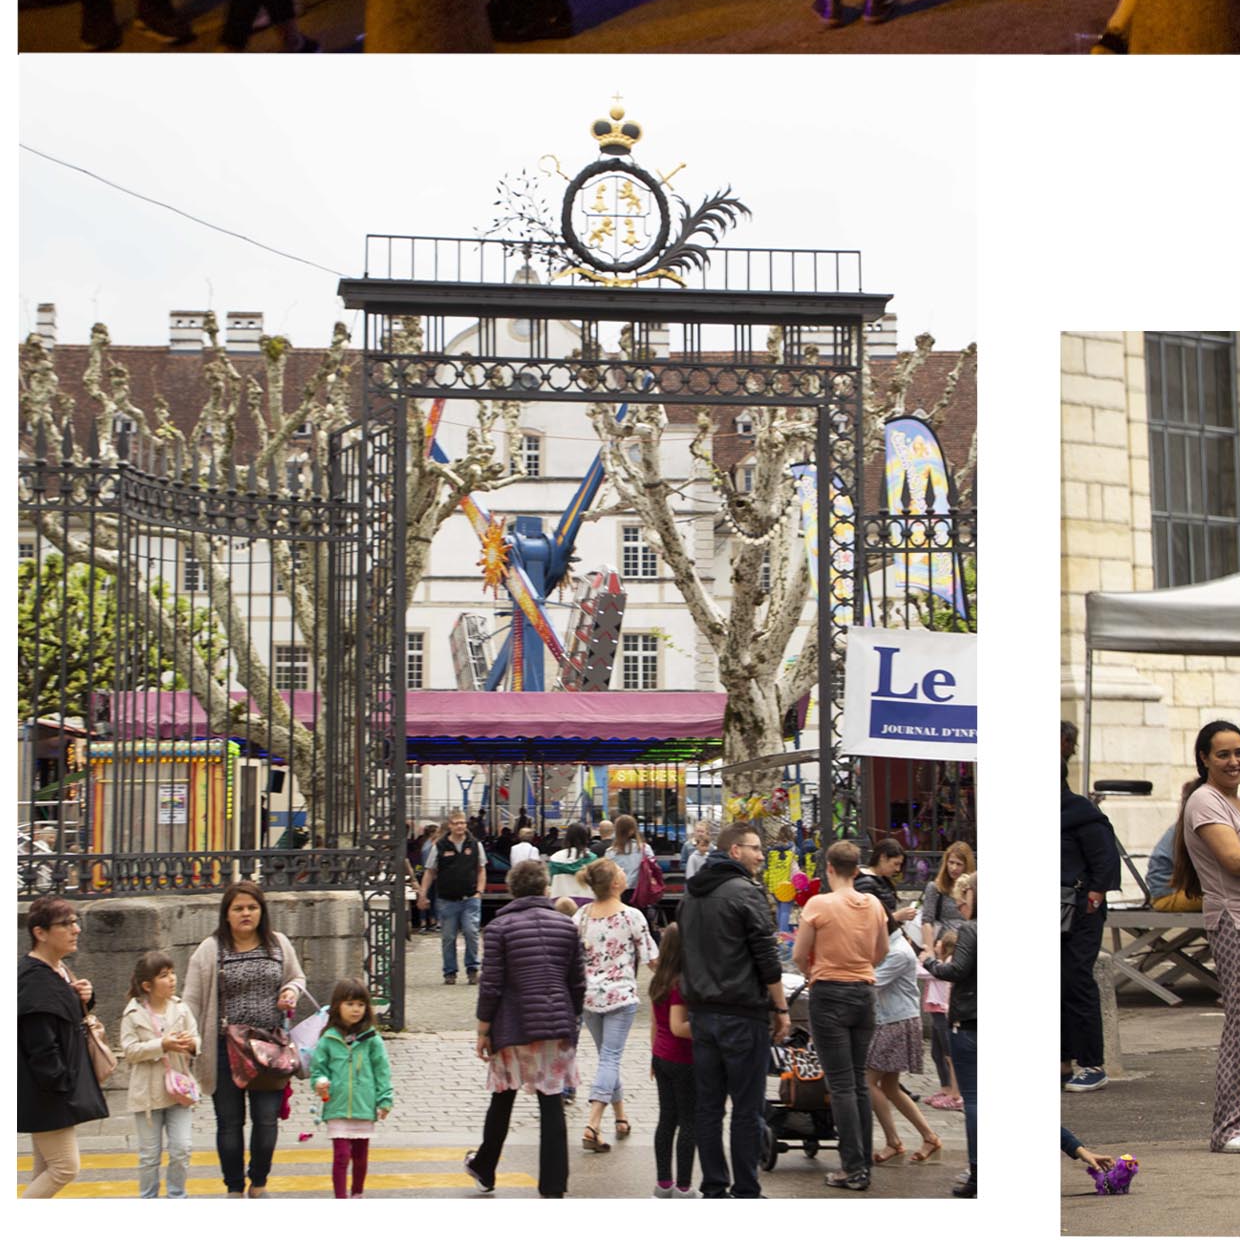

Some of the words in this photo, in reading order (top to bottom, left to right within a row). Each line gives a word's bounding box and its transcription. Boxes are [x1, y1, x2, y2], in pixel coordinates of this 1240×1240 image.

[871, 646, 956, 702] Le
[881, 724, 939, 737] JOURNAL
[942, 728, 977, 738] D'INF
